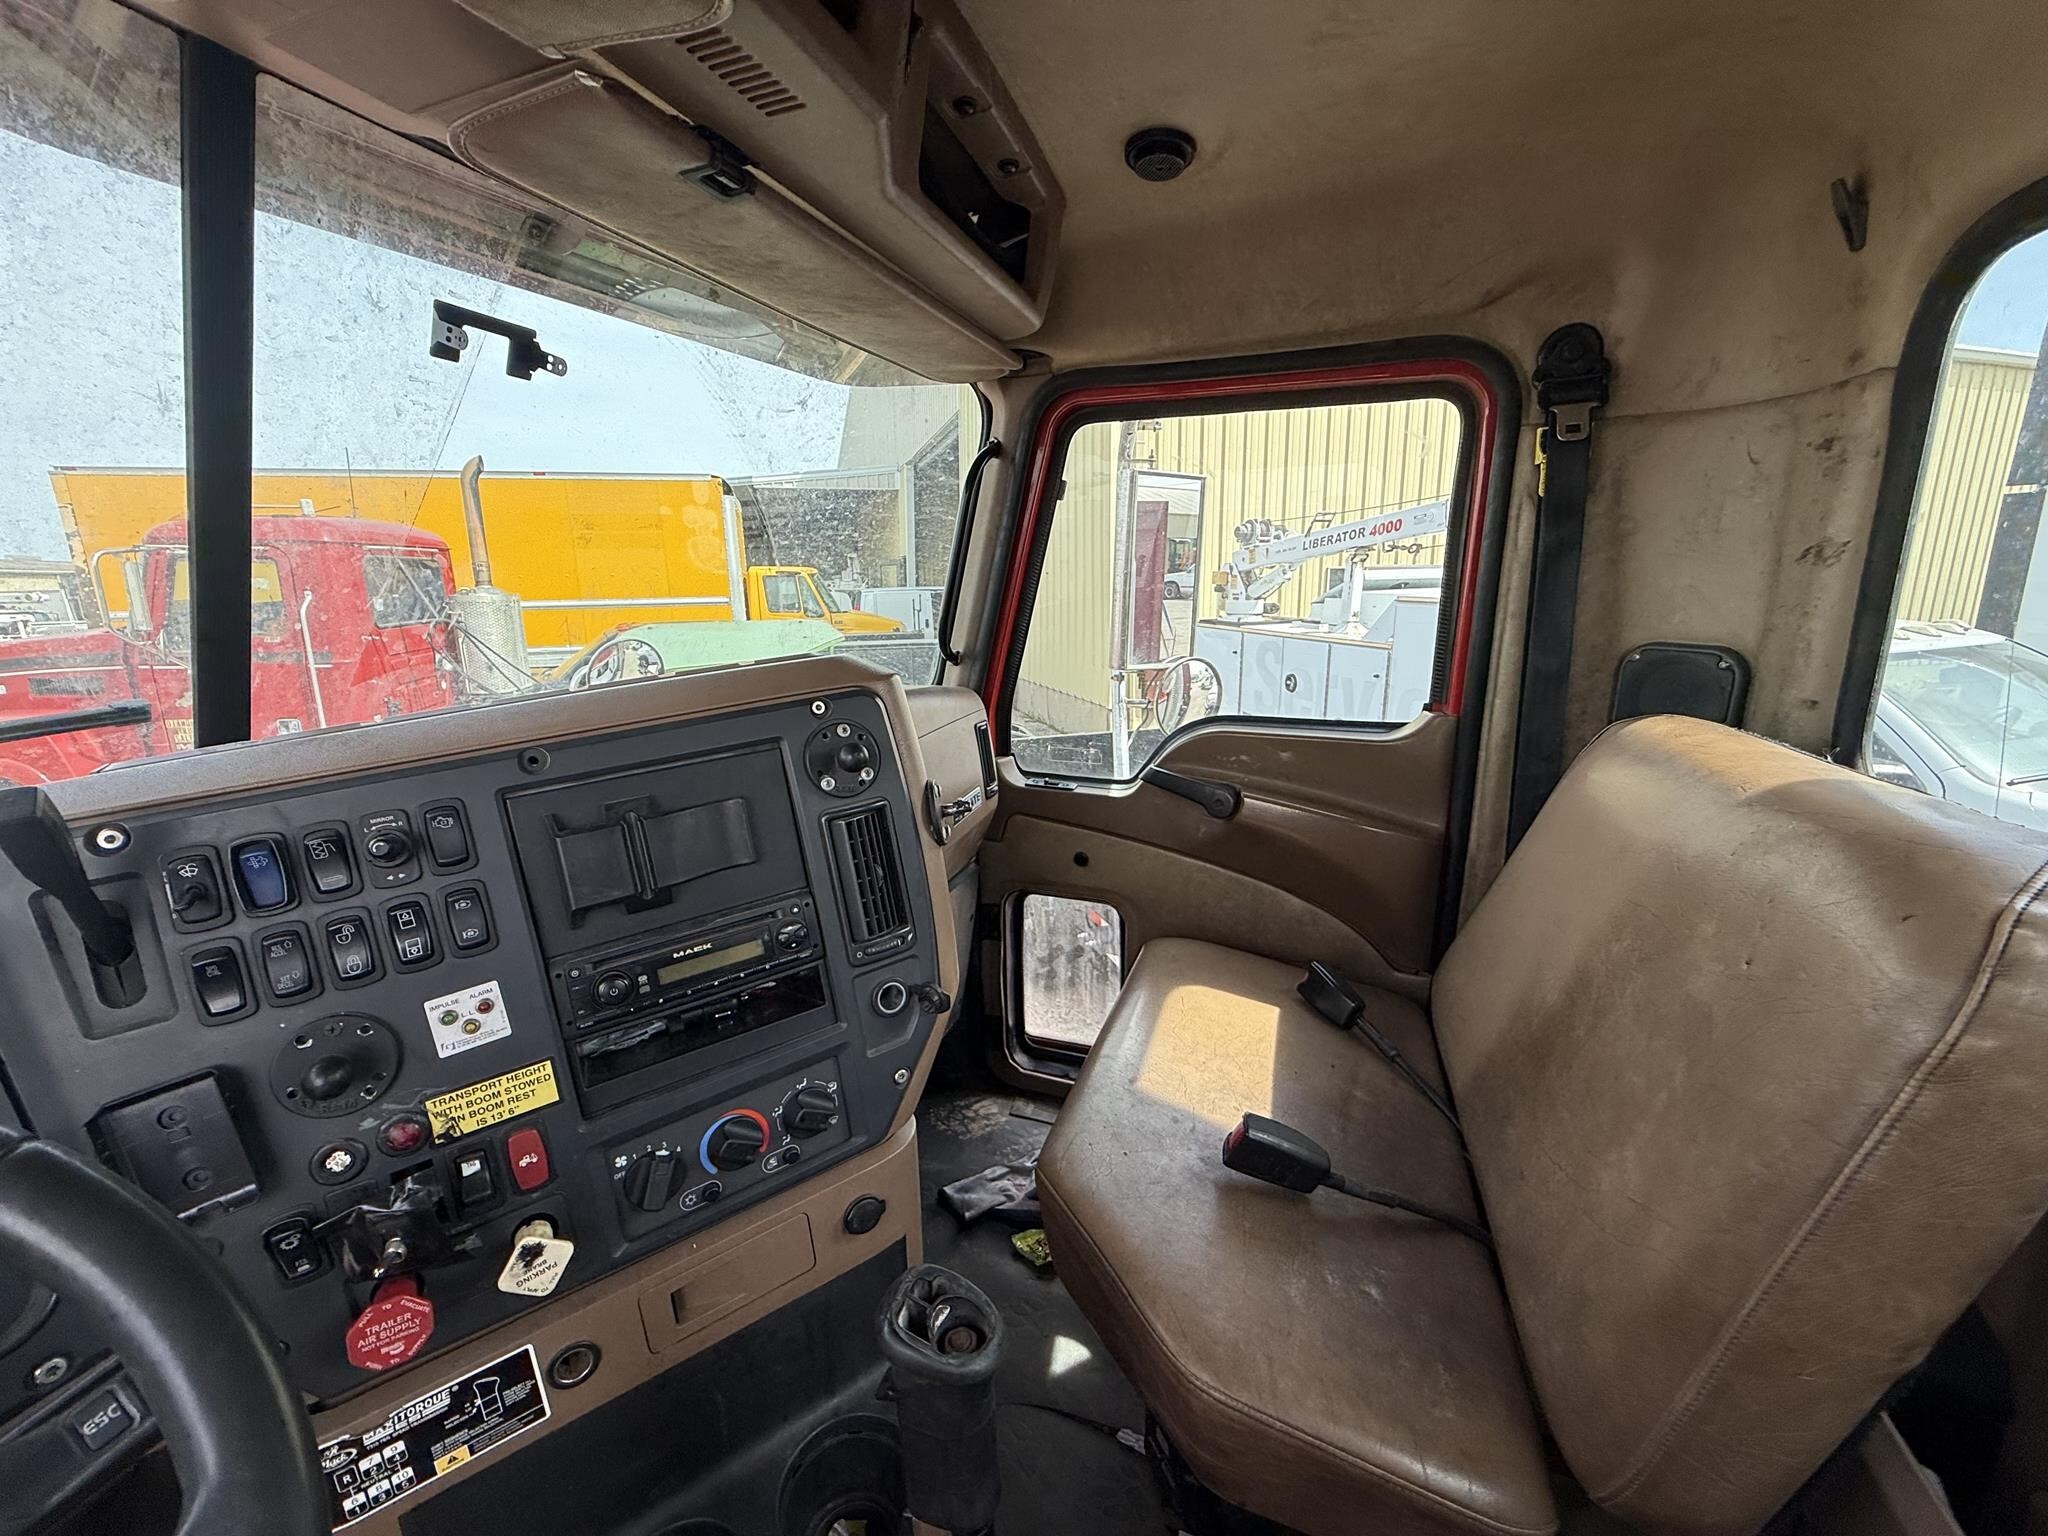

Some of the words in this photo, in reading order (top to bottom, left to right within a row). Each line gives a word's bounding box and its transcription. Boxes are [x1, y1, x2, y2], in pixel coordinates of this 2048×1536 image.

[1302, 527, 1366, 551] LIBERATOR
[1369, 518, 1403, 537] 4000
[370, 816, 394, 824] MIRROR
[673, 942, 713, 959] MACK
[429, 999, 460, 1012] IMPULSE
[469, 988, 494, 1000] ALARM
[431, 1079, 503, 1109] TRANSPORT
[506, 1063, 547, 1084] HEIGHT
[432, 1104, 462, 1120] WITH
[466, 1090, 501, 1109] BOOM
[505, 1073, 551, 1095] STOWED
[469, 1101, 505, 1121] BOOM
[507, 1089, 537, 1104] REST
[476, 1118, 488, 1127] IS
[662, 1141, 667, 1149] 3
[613, 1170, 626, 1180] OFF
[516, 1261, 558, 1288] PARKING
[358, 1312, 374, 1328] PULL
[400, 1299, 430, 1313] EVACUATE
[365, 1312, 412, 1336] TRAILER
[358, 1335, 377, 1348] AIR
[380, 1317, 422, 1339] SUPPLY
[361, 1344, 376, 1352] NOT
[376, 1338, 390, 1347] FOR
[83, 1402, 122, 1435] ESC
[363, 1388, 451, 1441] MAXITORQUE
[343, 1474, 352, 1485] R
[391, 1446, 397, 1454] 9
[369, 1466, 378, 1476] 2
[393, 1454, 401, 1462] 4
[397, 1471, 409, 1482] 10
[354, 1506, 360, 1514] 1
[378, 1493, 386, 1502] 3
[401, 1481, 410, 1489] 5
